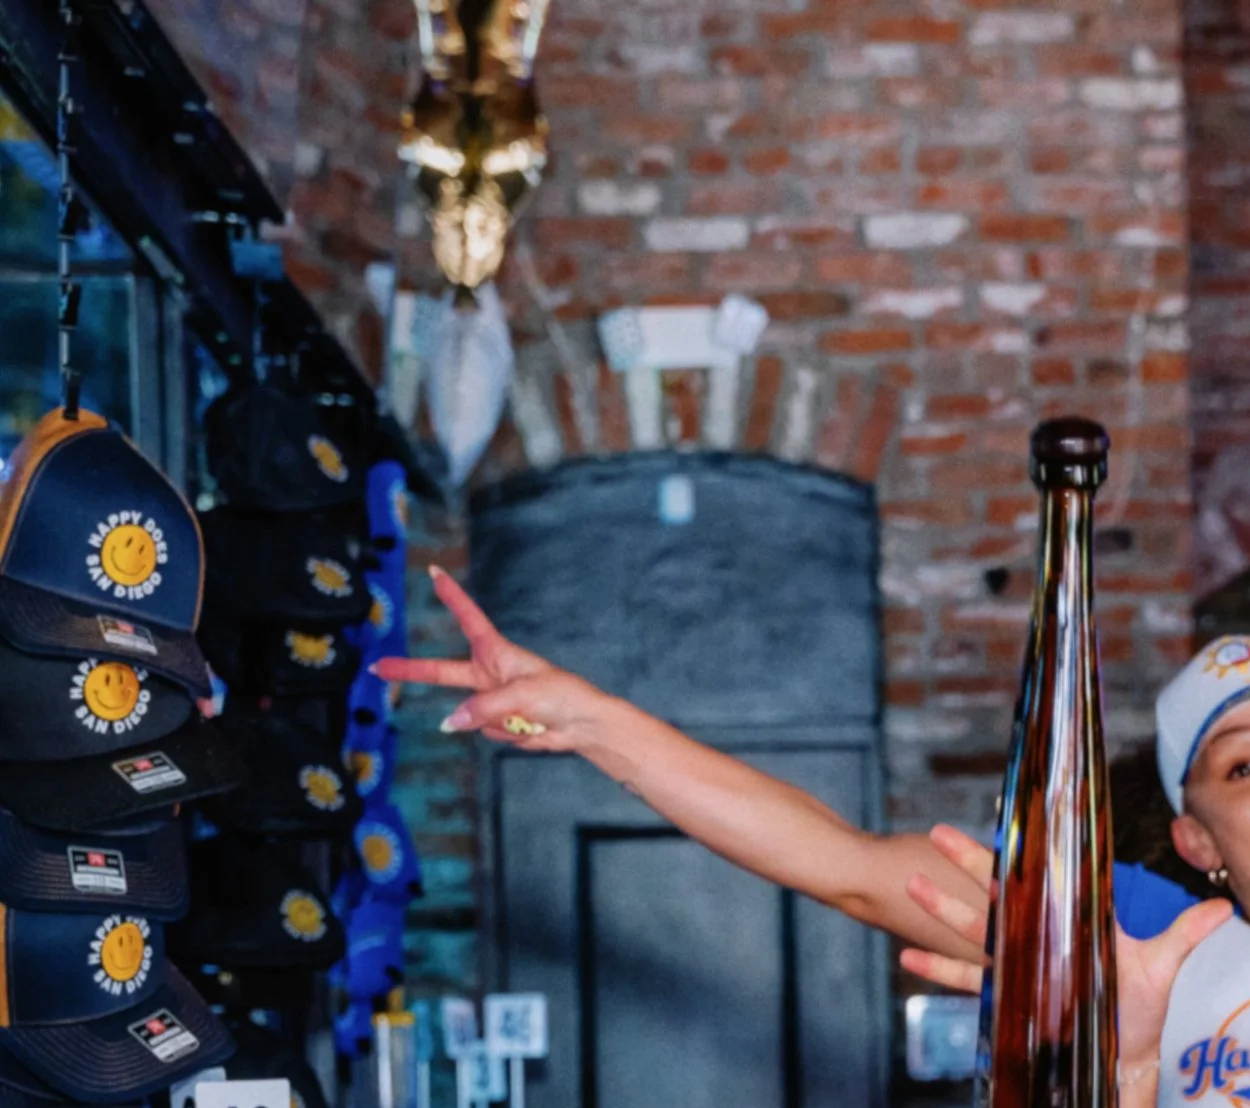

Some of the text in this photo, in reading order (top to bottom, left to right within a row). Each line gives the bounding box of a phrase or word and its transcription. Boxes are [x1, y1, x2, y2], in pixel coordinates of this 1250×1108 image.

[88, 509, 168, 564] HAPPY DOES
[86, 553, 162, 600] SAN DIEGO
[75, 689, 151, 734] SAN DIEGO
[93, 969, 122, 996] SAN
